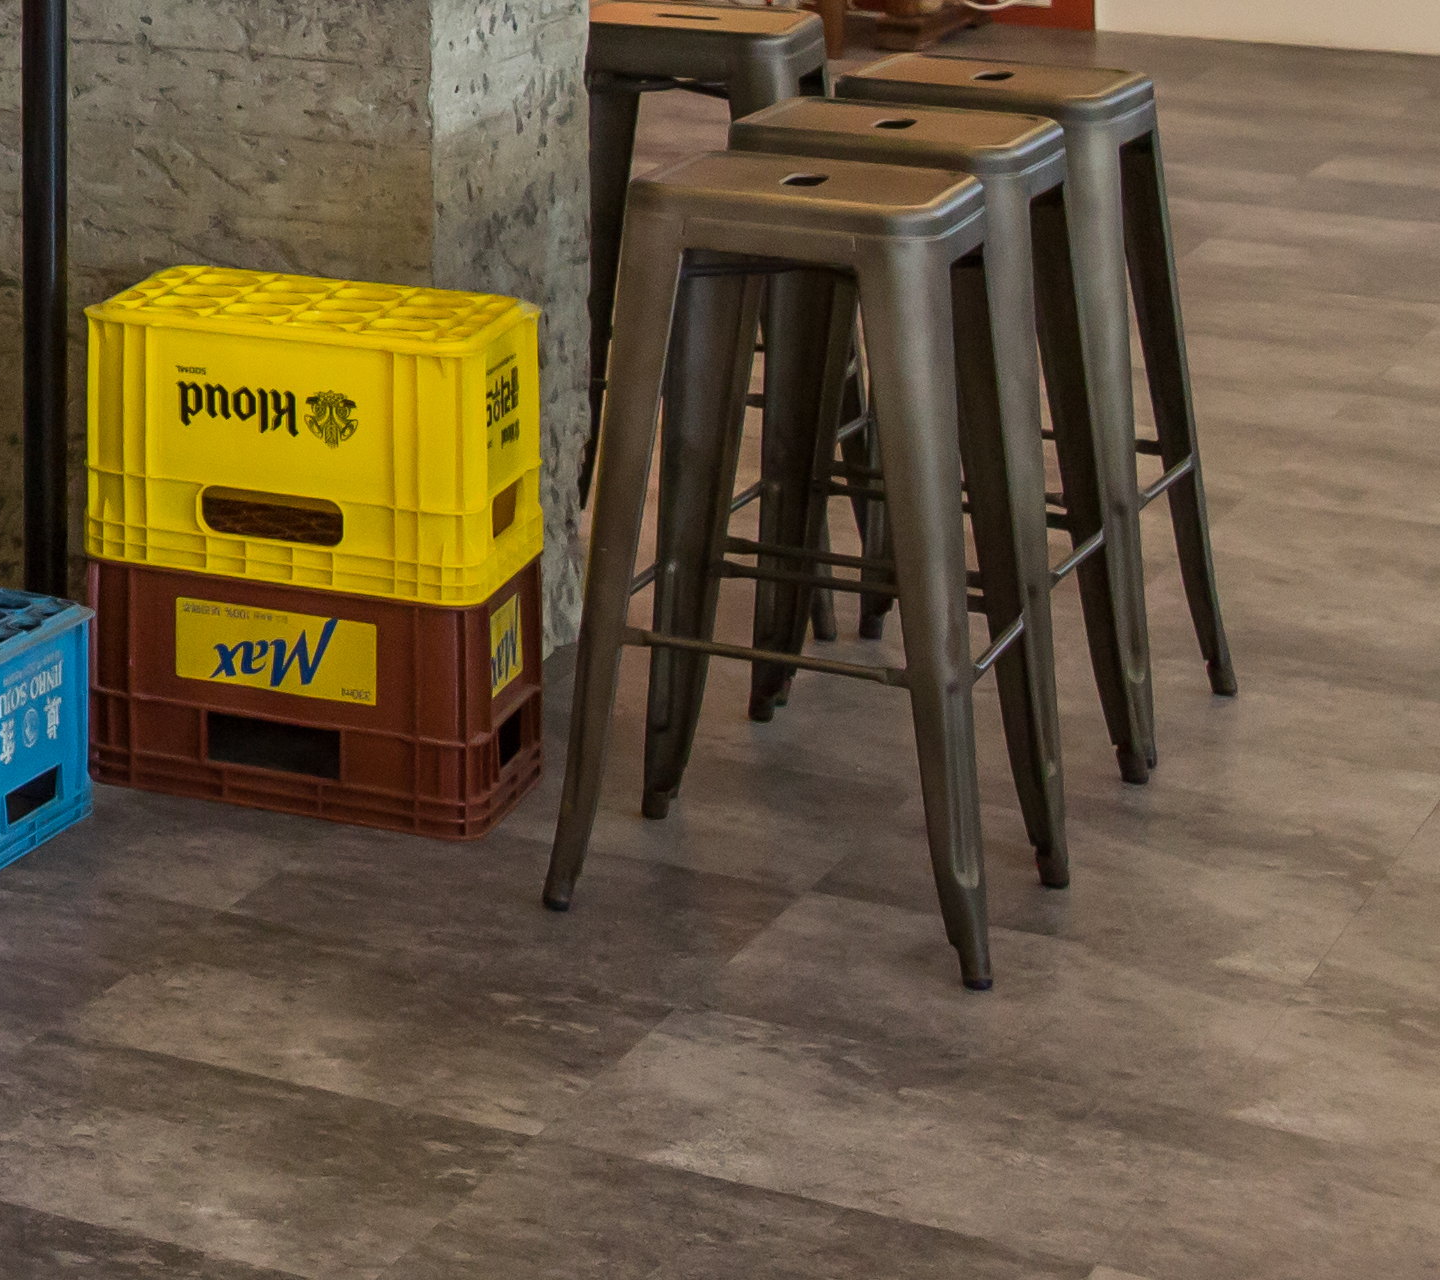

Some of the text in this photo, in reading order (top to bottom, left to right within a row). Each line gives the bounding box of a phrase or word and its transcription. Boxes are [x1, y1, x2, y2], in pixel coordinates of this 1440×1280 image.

[176, 380, 299, 438] Kloud
[30, 659, 63, 700] JINRO
[209, 618, 339, 688] Max
